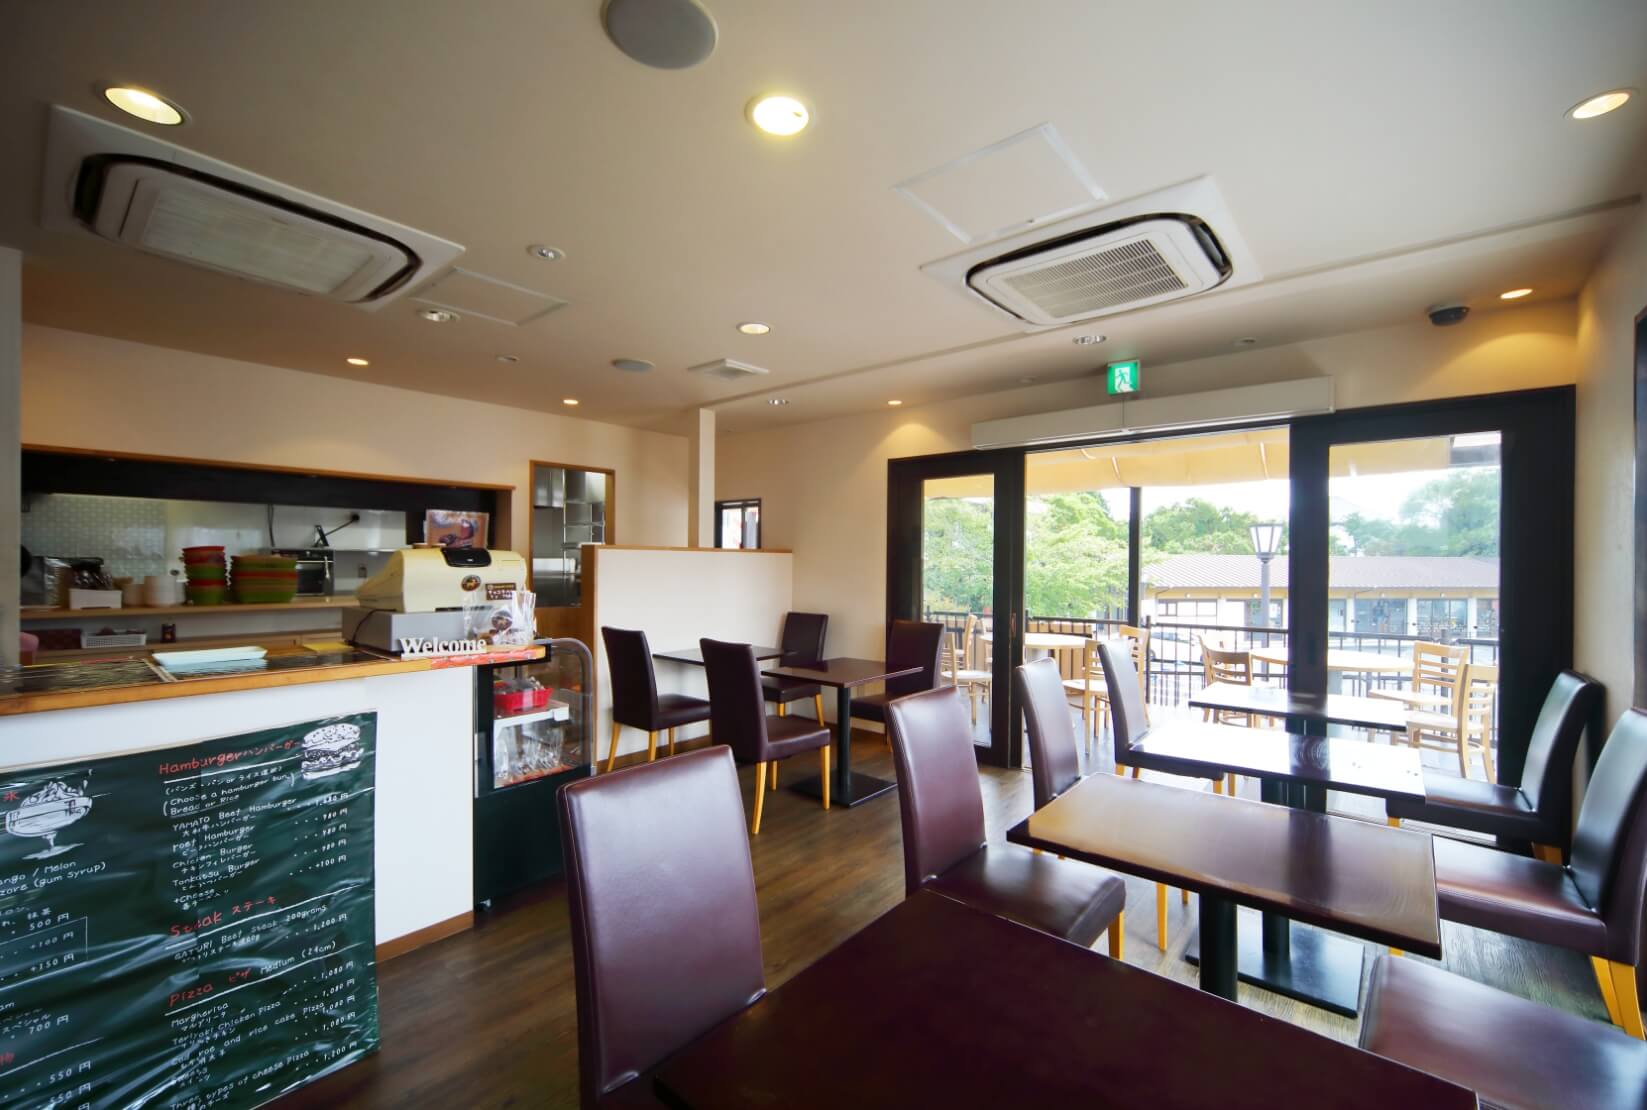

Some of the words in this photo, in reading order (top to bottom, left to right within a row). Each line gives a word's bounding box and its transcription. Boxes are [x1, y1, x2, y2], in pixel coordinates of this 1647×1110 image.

[400, 636, 486, 655] Welcome
[159, 751, 241, 775] Hamburger
[169, 793, 208, 806] Choose
[221, 779, 269, 796] hamburger
[170, 802, 202, 816] Bread
[220, 794, 241, 805] Rice
[173, 815, 212, 832] YAMATO
[218, 808, 242, 821] Beef
[248, 798, 297, 814] Hamburger
[204, 824, 256, 842] Hamburger
[220, 843, 255, 858] Burger
[34, 875, 63, 889] (gum
[67, 861, 106, 879] syrup)
[44, 861, 77, 874] Melon
[172, 870, 220, 887] Tonkatsu
[227, 858, 261, 874] Burger
[29, 918, 52, 931] 500
[57, 912, 70, 923] 円
[63, 931, 74, 941] 円
[63, 953, 75, 963] 円
[29, 1021, 51, 1035] 700
[56, 1014, 70, 1026] 円
[223, 1035, 241, 1047] and
[249, 1025, 268, 1037] rice
[49, 1068, 73, 1084] 550
[79, 1060, 92, 1073] 円
[78, 1083, 92, 1095] 円
[206, 1082, 234, 1100] types
[238, 1076, 249, 1087] of
